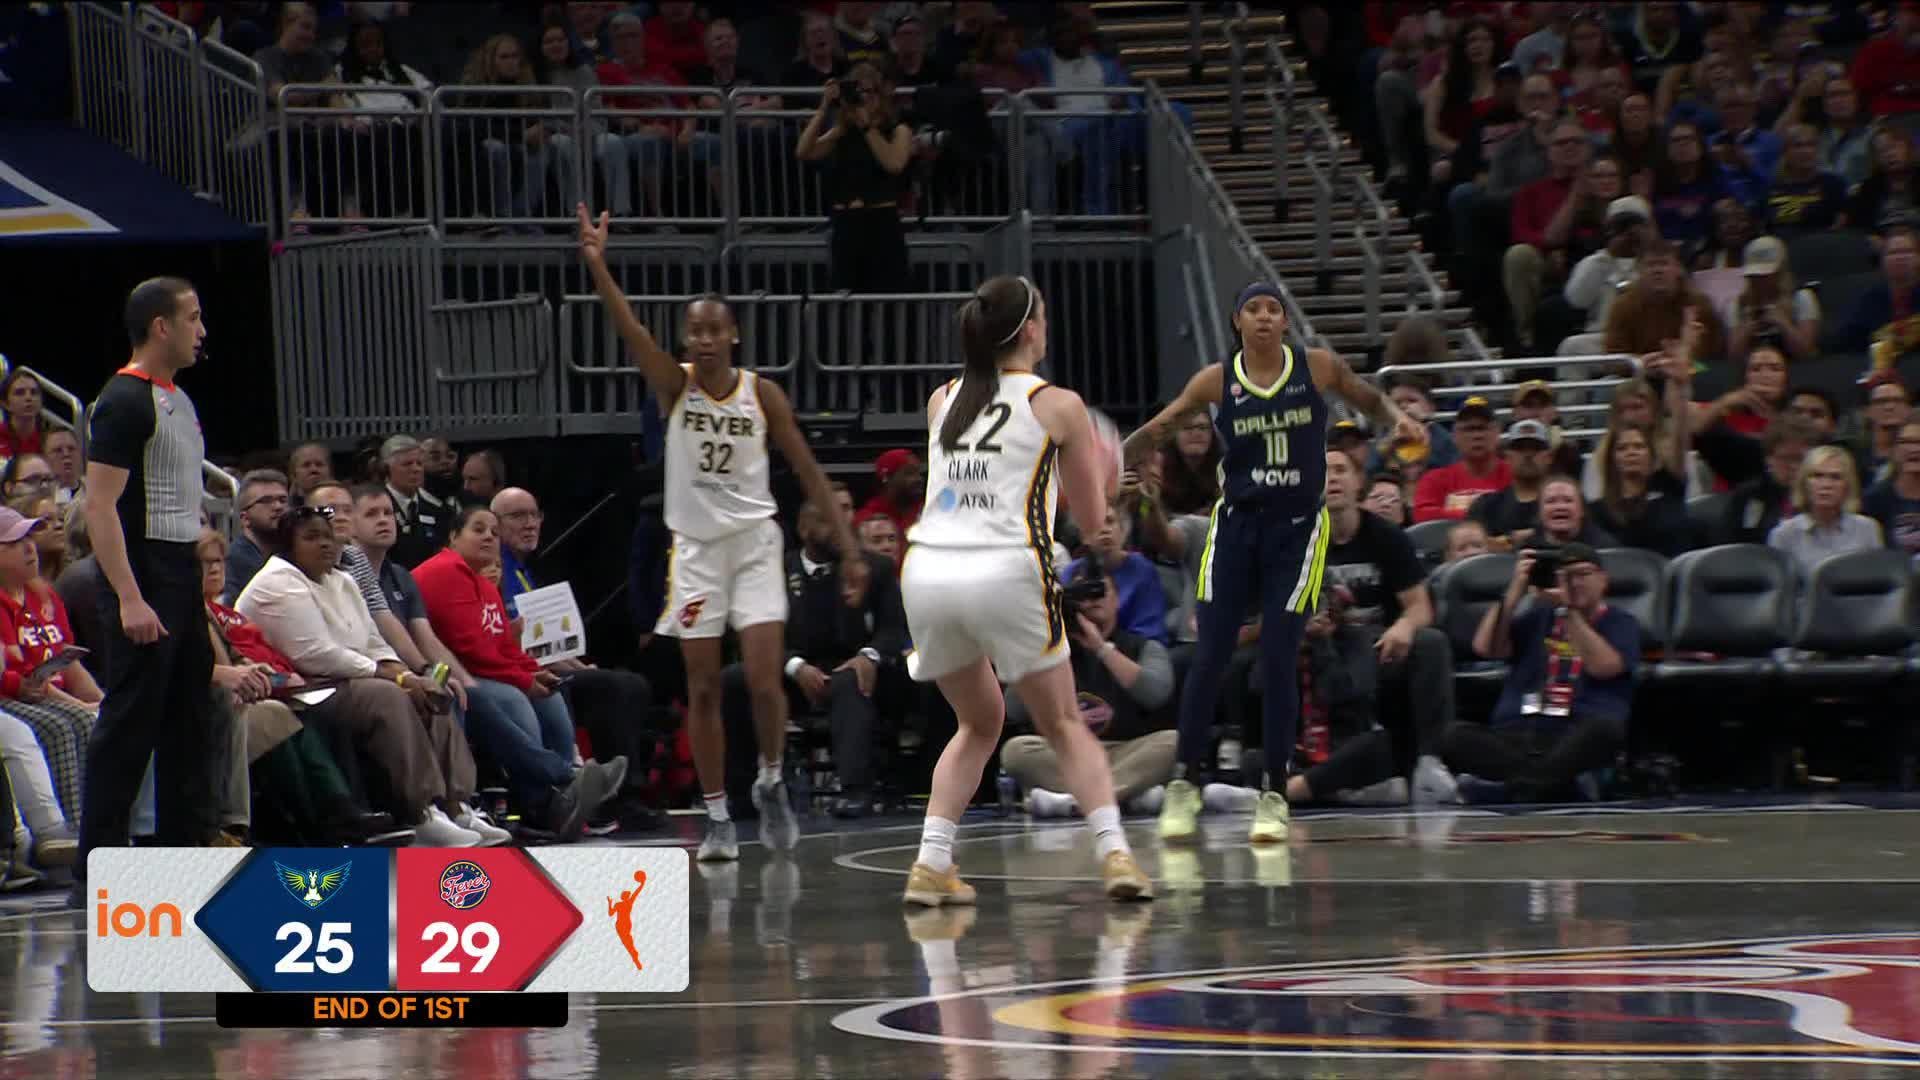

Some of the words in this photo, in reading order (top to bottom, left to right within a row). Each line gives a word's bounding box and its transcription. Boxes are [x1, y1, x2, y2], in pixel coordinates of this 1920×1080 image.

[683, 410, 754, 437] FEVER
[1233, 405, 1313, 437] DALLAS
[699, 441, 733, 474] 32
[1263, 431, 1289, 466] 10
[947, 458, 990, 481] CLARK
[1265, 469, 1301, 487] CVS
[960, 492, 998, 510] AT&T
